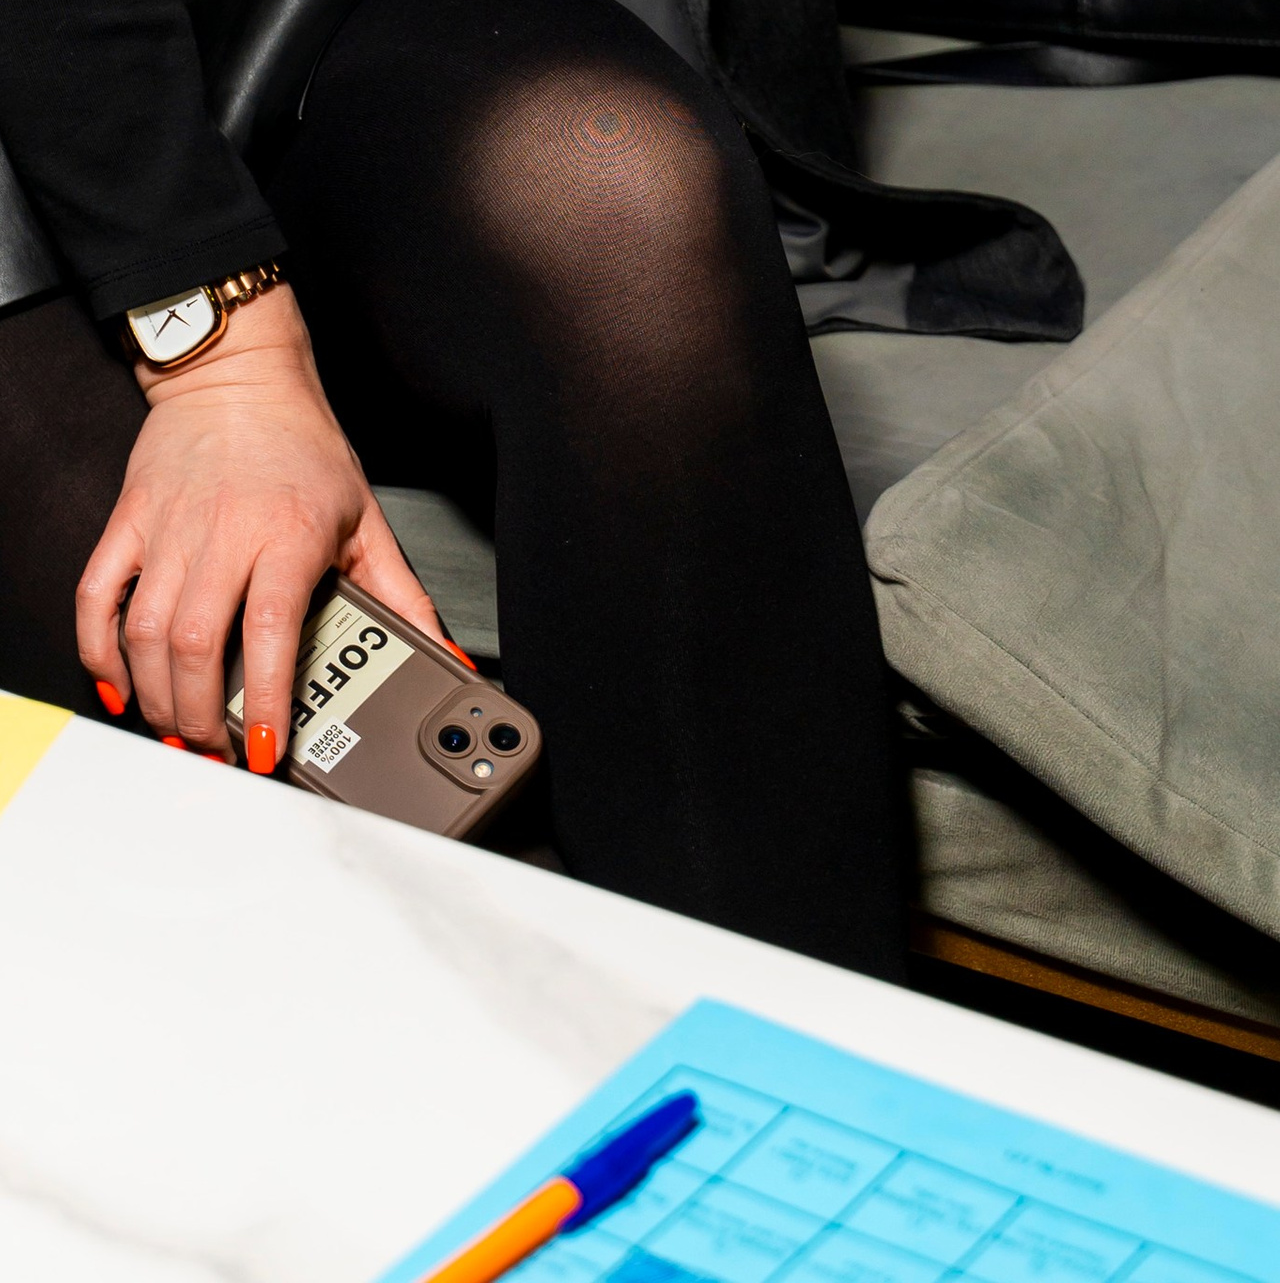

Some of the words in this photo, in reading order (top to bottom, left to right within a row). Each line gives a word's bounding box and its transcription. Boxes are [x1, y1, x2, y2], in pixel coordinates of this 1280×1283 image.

[335, 612, 353, 629] LIGHT
[308, 724, 338, 755] COFFEE
[314, 728, 344, 759] ROASTED
[320, 735, 352, 764] 100%
